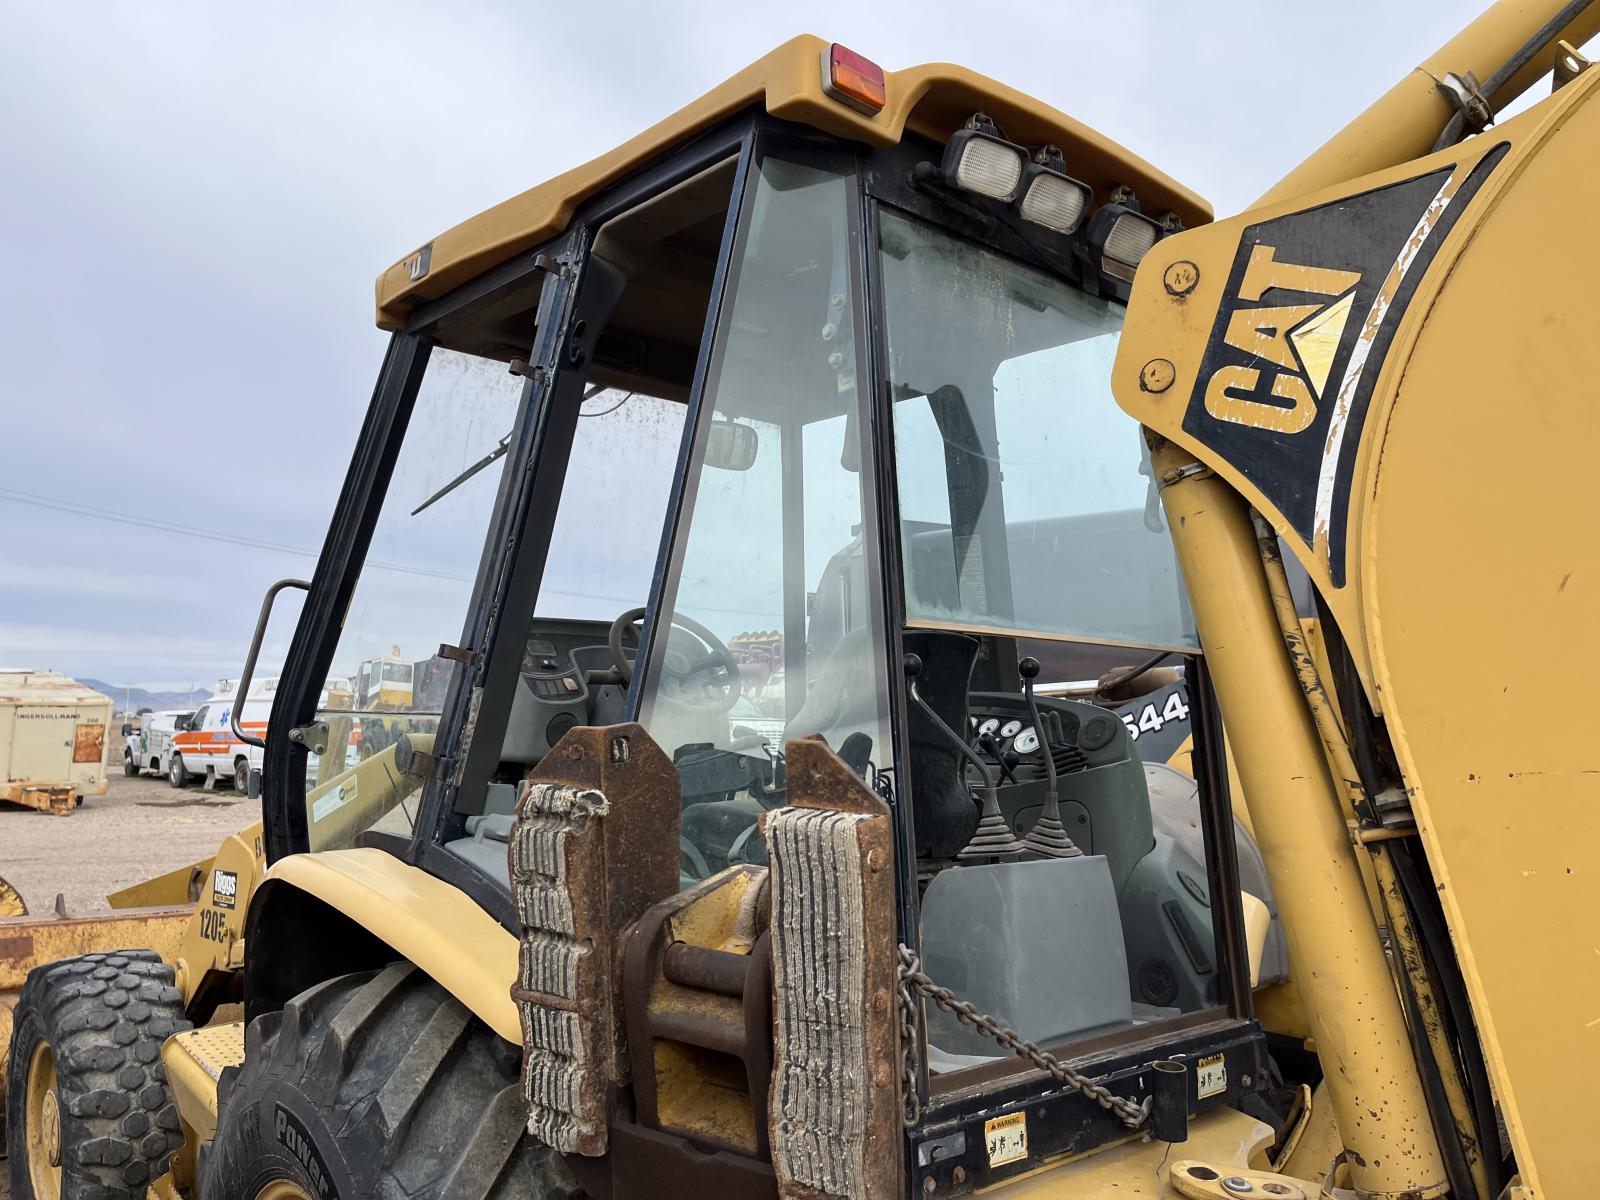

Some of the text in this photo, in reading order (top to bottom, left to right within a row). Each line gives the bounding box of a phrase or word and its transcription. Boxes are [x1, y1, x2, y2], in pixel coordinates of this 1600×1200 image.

[1204, 244, 1362, 434] CAT
[1121, 692, 1189, 741] 544
[215, 870, 236, 895] Riggs
[200, 908, 226, 944] 1205
[277, 1109, 329, 1199] Power
